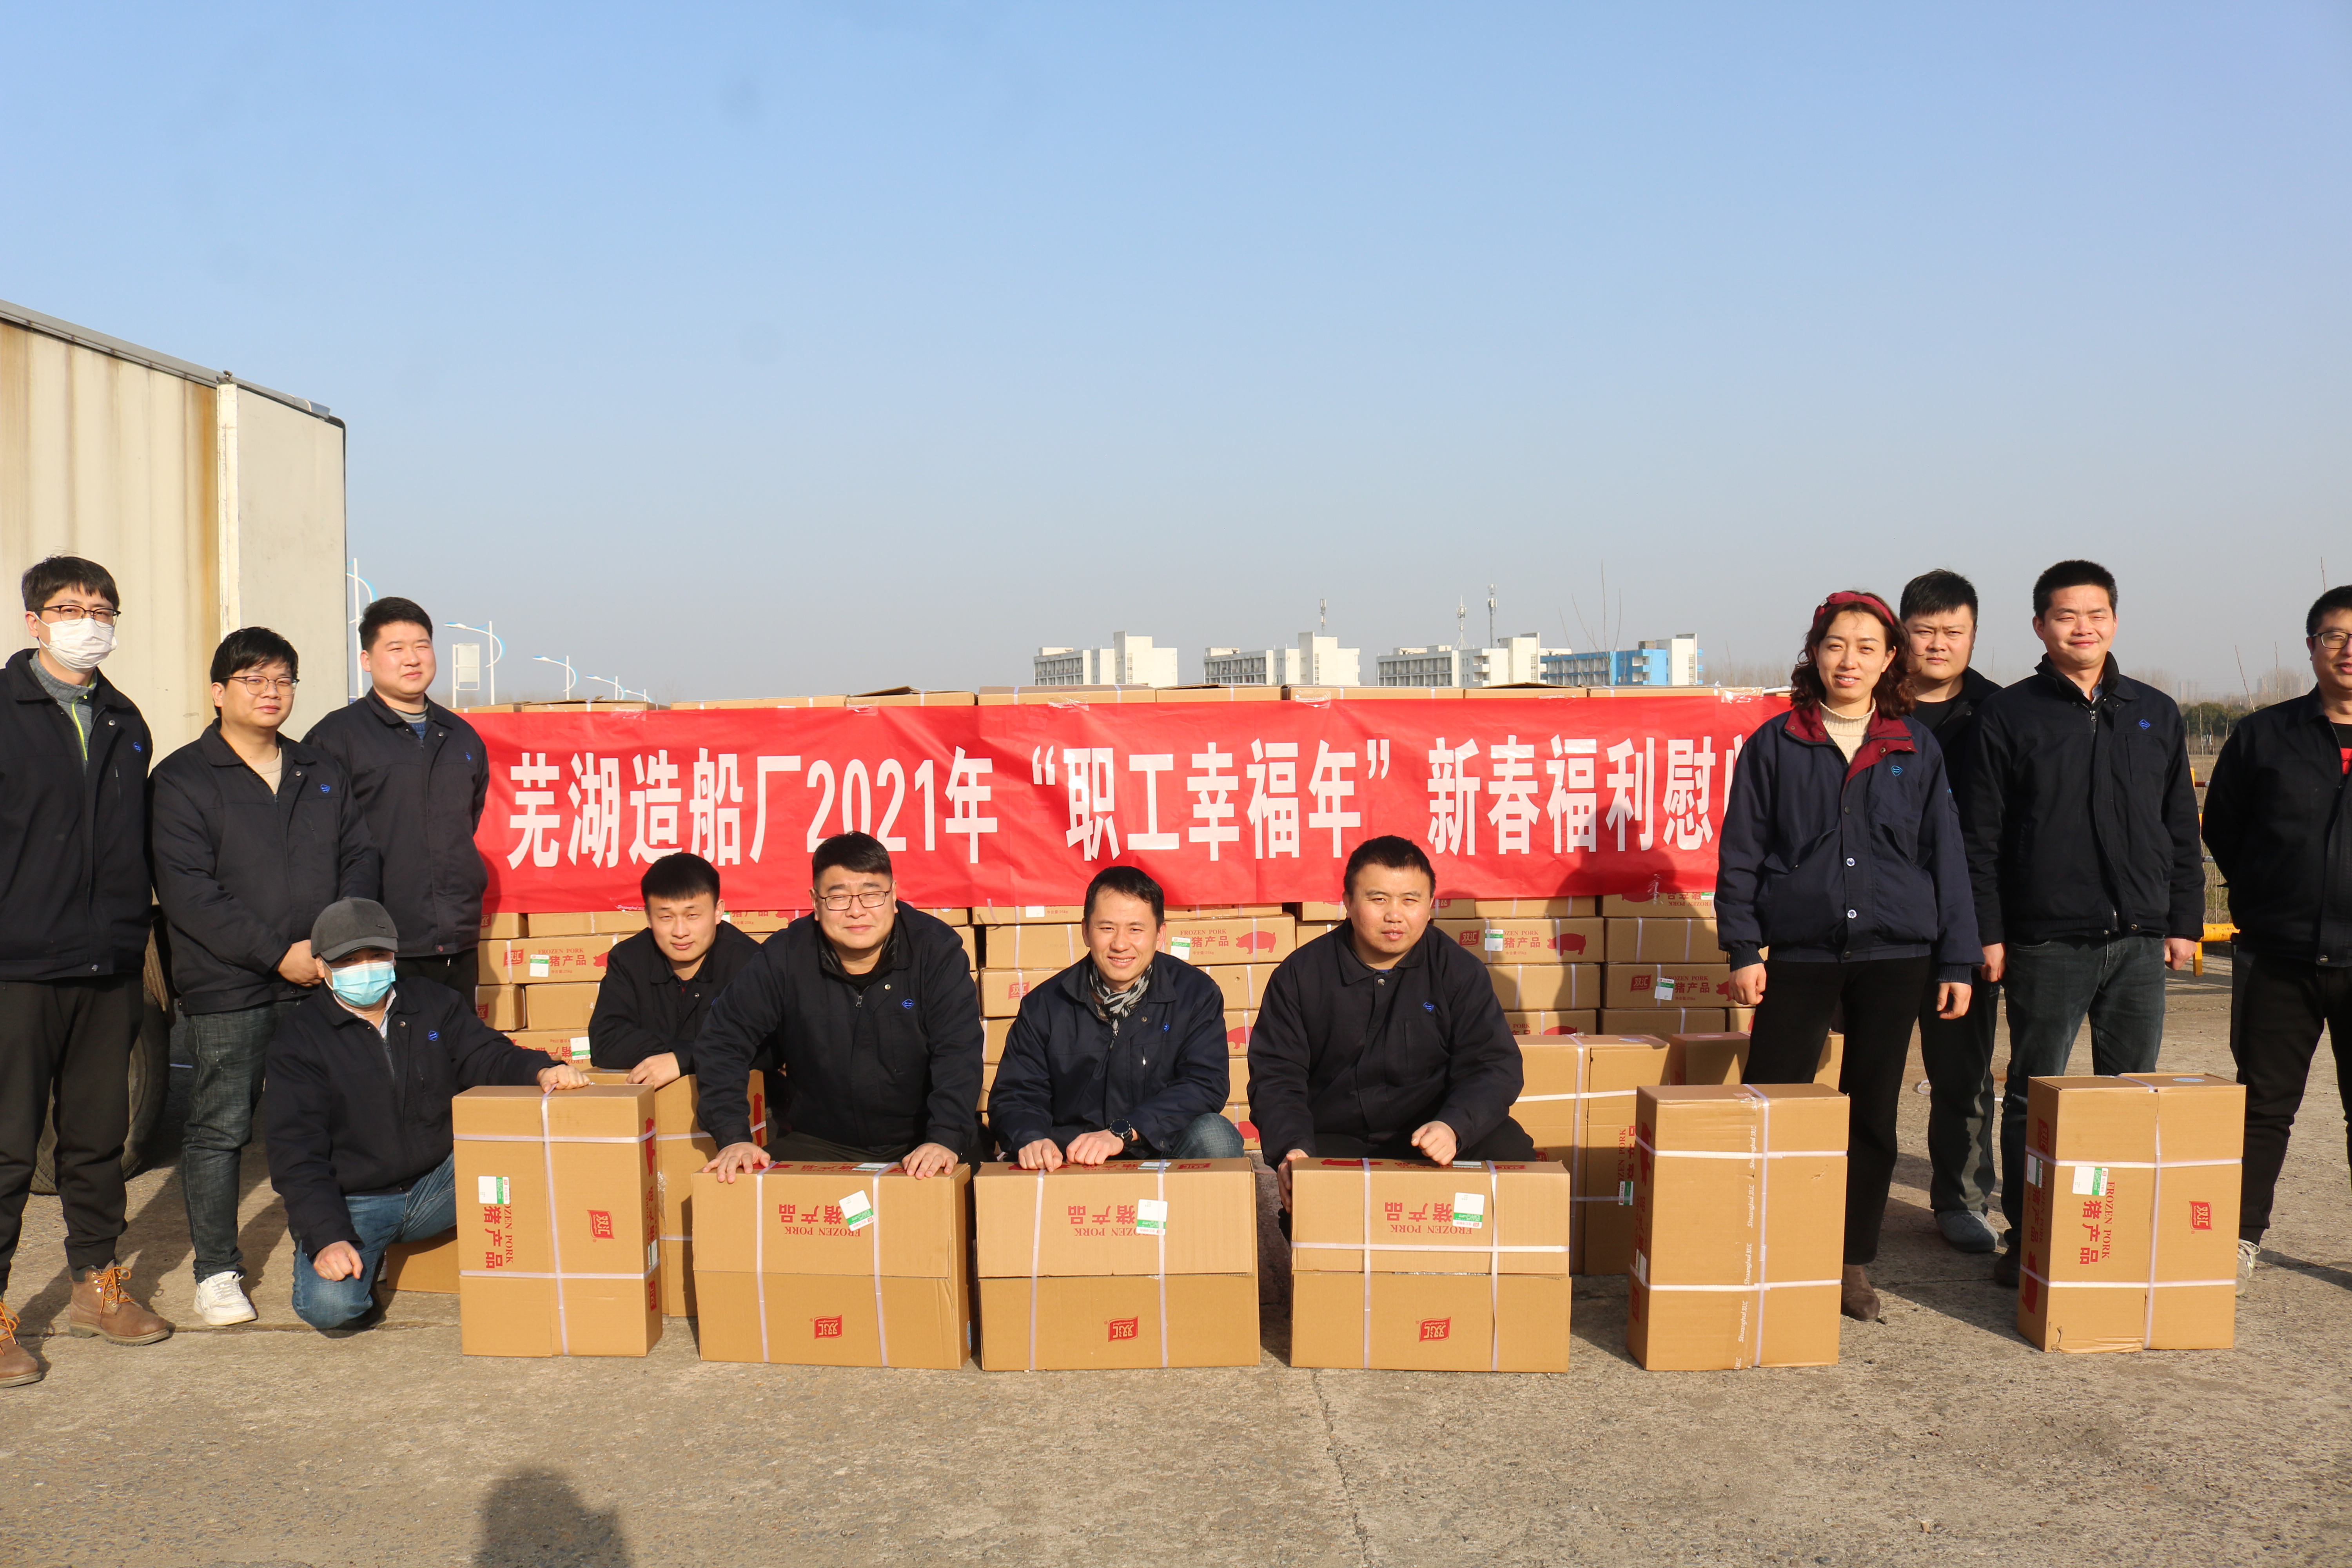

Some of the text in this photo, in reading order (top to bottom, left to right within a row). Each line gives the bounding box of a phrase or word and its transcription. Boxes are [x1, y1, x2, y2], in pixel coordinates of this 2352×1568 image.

[507, 734, 1743, 869] 芜湖造船厂2021年“职工幸福年”新春福利慰
[1192, 936, 1229, 947] 猪产品
[1462, 933, 1477, 942] 双汇
[1504, 937, 1541, 948] 猪产品
[550, 955, 586, 967] 猪产品
[1633, 977, 1648, 987] 双汇
[1675, 982, 1710, 993] 猪产品
[779, 1204, 842, 1225] 猪产品
[1068, 1205, 1135, 1225] 猪产品
[1385, 1202, 1452, 1223] 猪产品
[2030, 1187, 2041, 1243] 猪产品
[2102, 1181, 2115, 1258] FROZEN PORK
[2196, 1205, 2209, 1226] 双汇
[596, 1214, 610, 1235] 双汇
[784, 1226, 861, 1237] FROZEN PORK
[1074, 1227, 1105, 1236] PORK
[1390, 1224, 1472, 1234] FROZEN PORK
[2080, 1200, 2102, 1265] 猪产品
[484, 1206, 503, 1269] 猪产品
[505, 1235, 513, 1263] PORK
[818, 1323, 838, 1336] 双汇
[1112, 1325, 1134, 1338] 双汇
[1423, 1325, 1446, 1339] 双汇
[1738, 1312, 1747, 1343] Shuanghui
